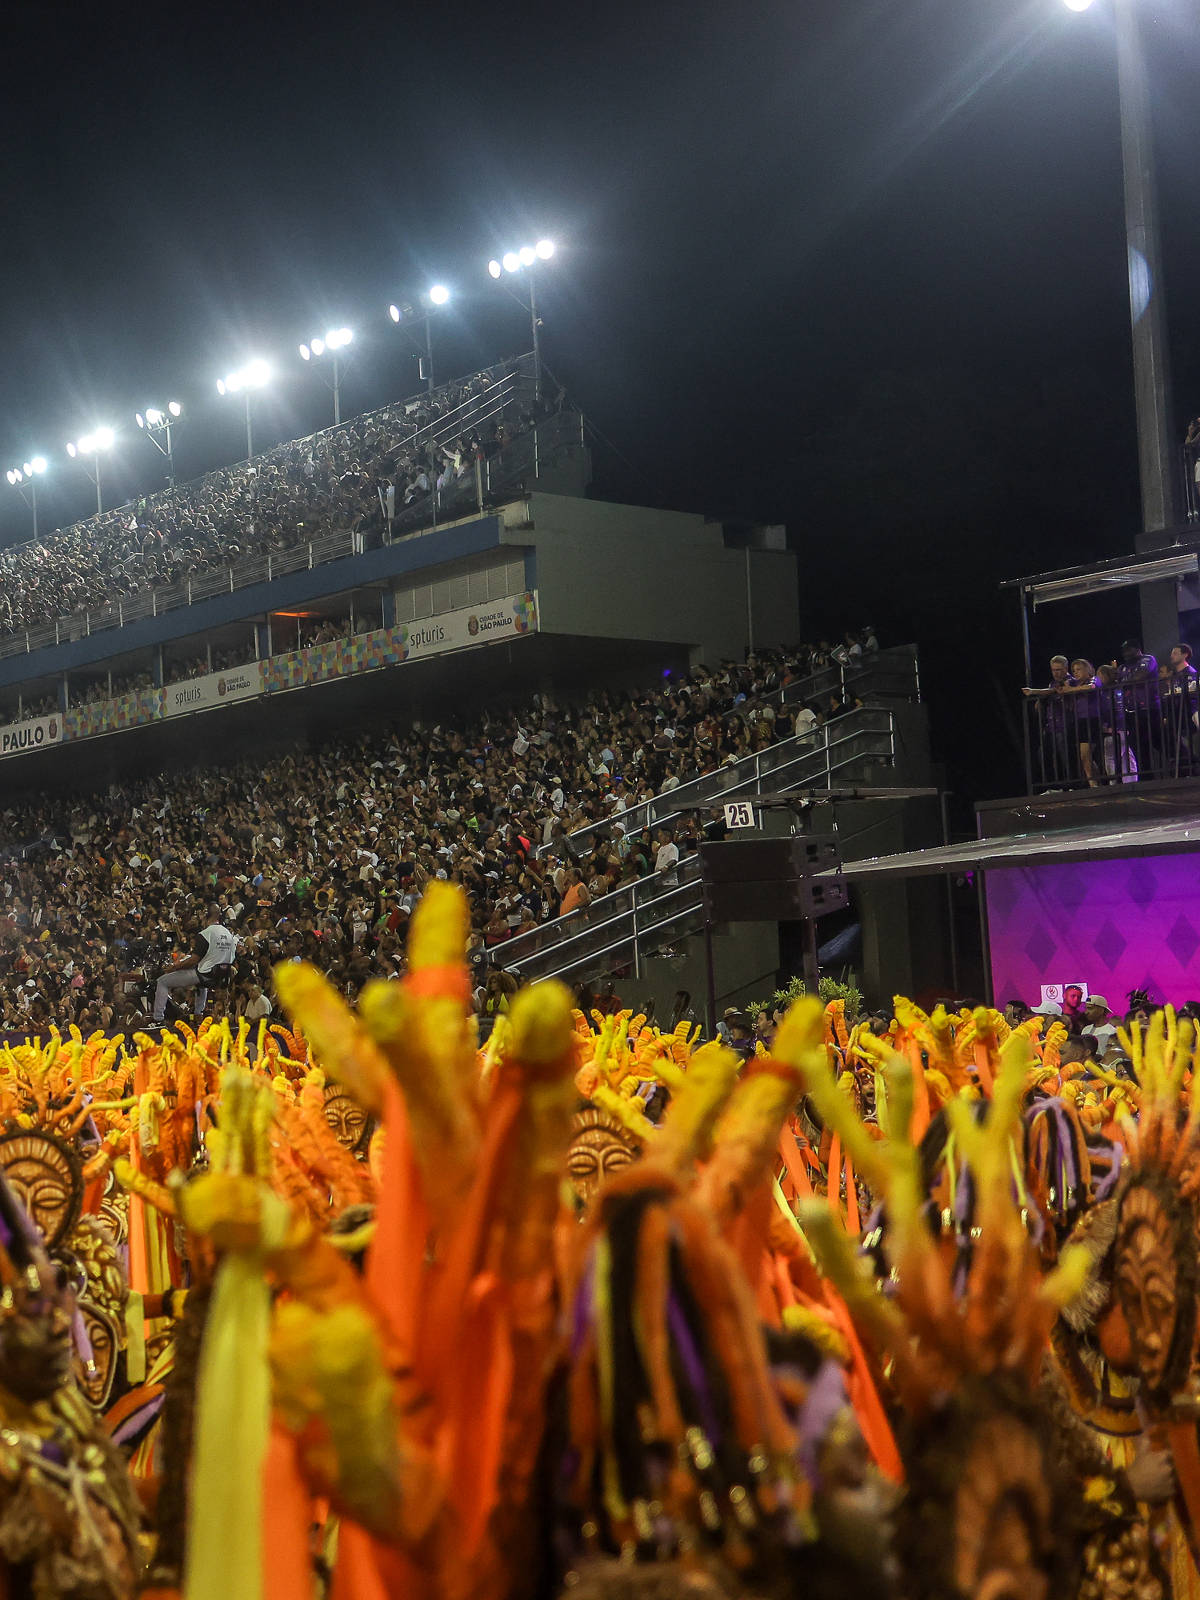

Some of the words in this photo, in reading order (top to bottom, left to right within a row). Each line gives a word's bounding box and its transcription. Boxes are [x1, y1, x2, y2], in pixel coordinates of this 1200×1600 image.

[493, 617, 512, 628] PAULO
[410, 625, 445, 648] spturis
[175, 685, 201, 706] spturis
[3, 726, 44, 751] PAULO
[728, 804, 749, 826] 25
